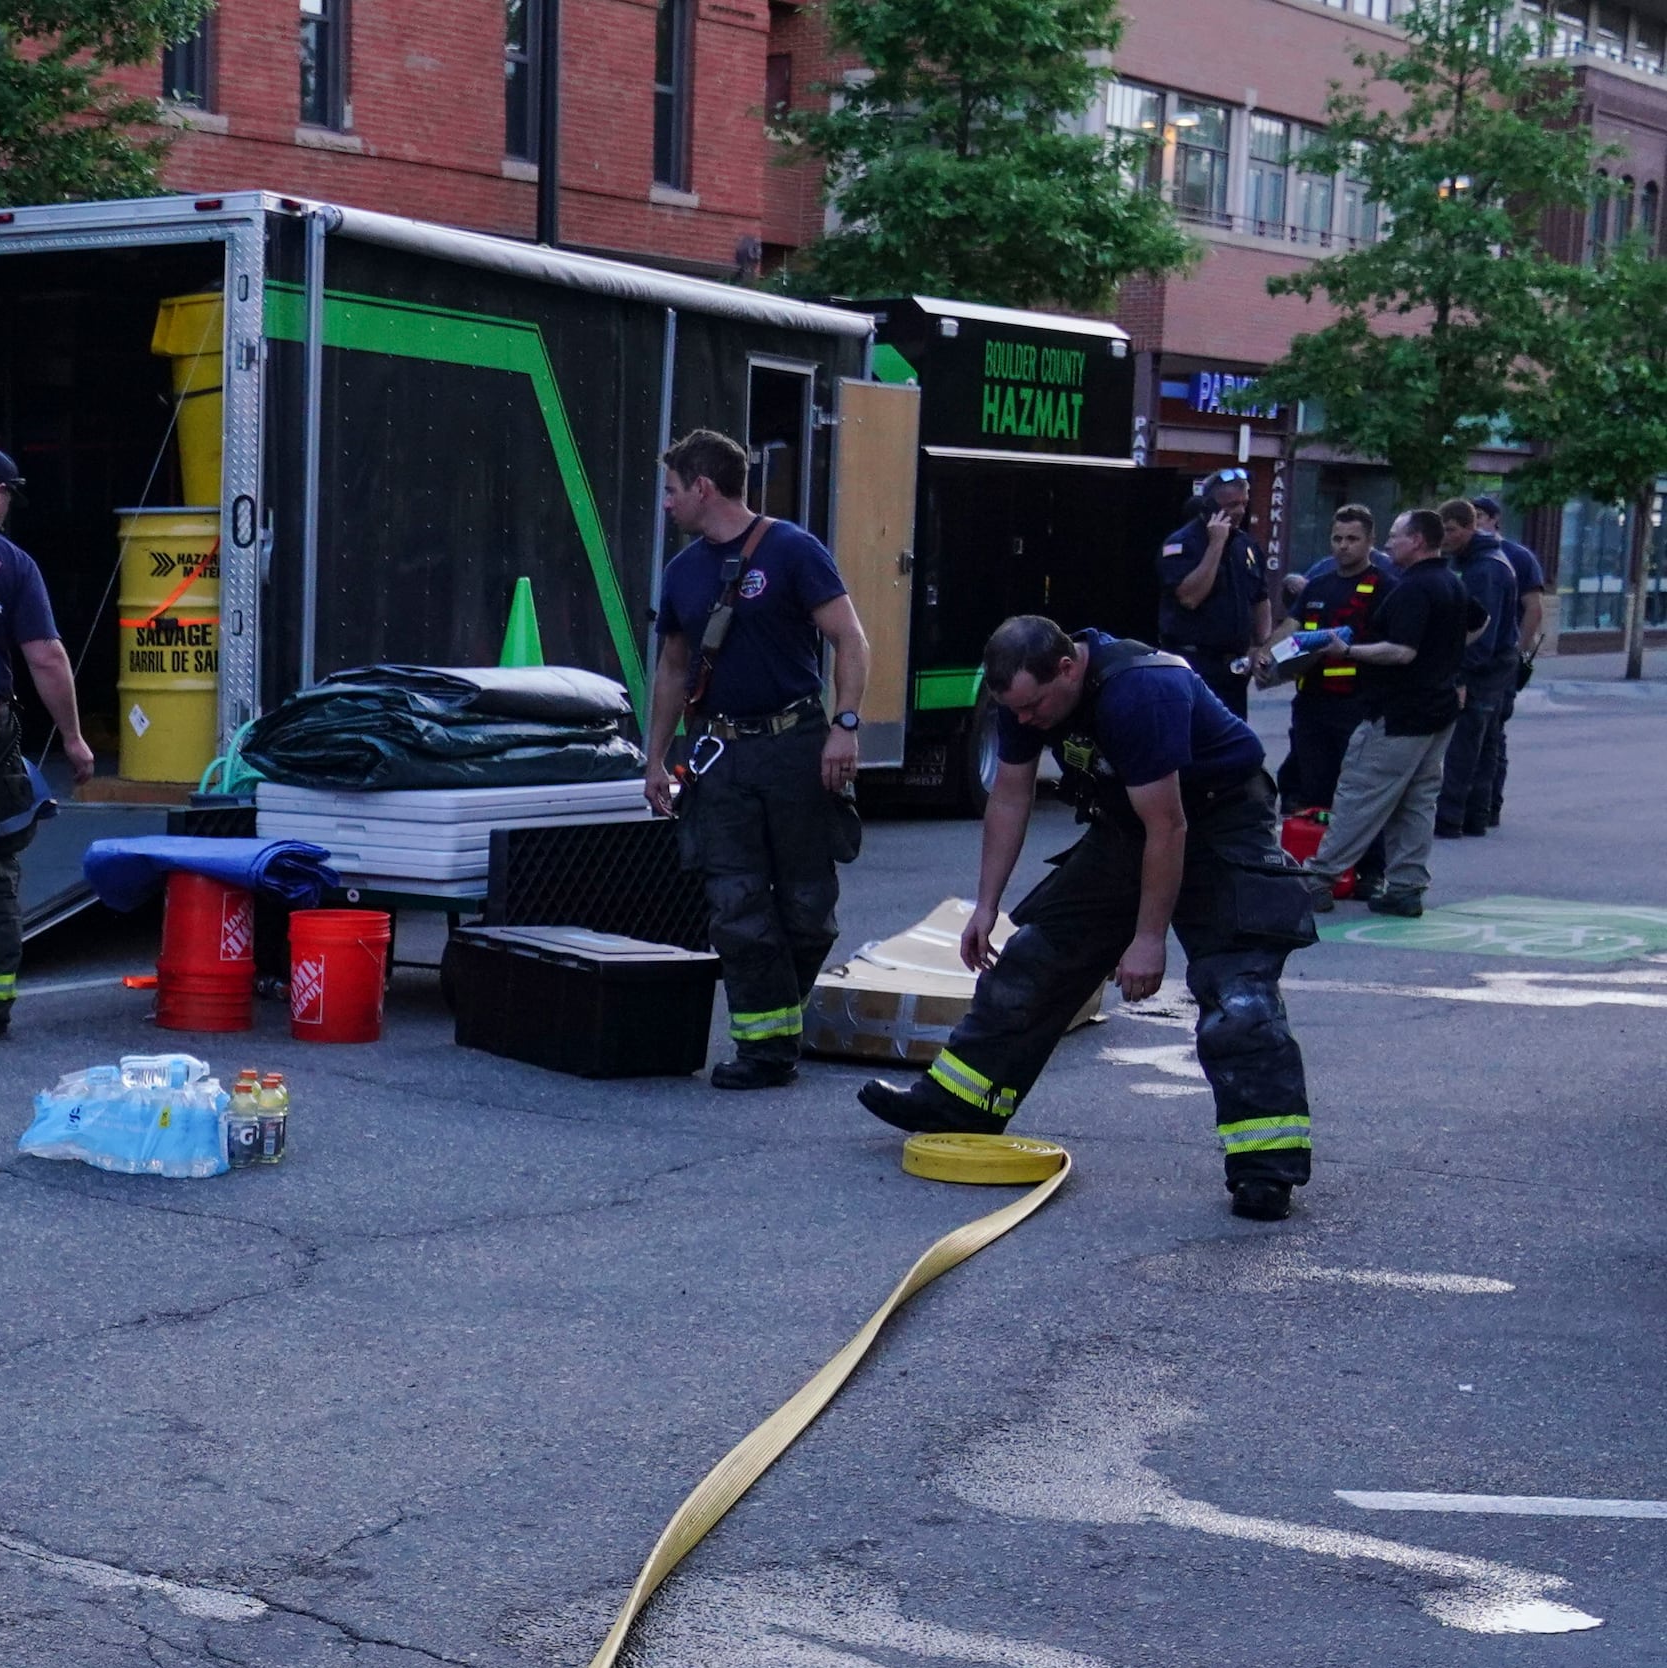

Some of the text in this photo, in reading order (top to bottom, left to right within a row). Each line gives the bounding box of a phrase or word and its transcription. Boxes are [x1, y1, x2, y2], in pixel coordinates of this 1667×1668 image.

[985, 340, 1086, 387] BOULDER COUNTY
[981, 384, 1084, 440] HAZMAT
[1267, 460, 1286, 570] PARKING
[137, 622, 212, 646] SALVAGE
[172, 650, 189, 673] DE
[238, 1128, 255, 1146] G
